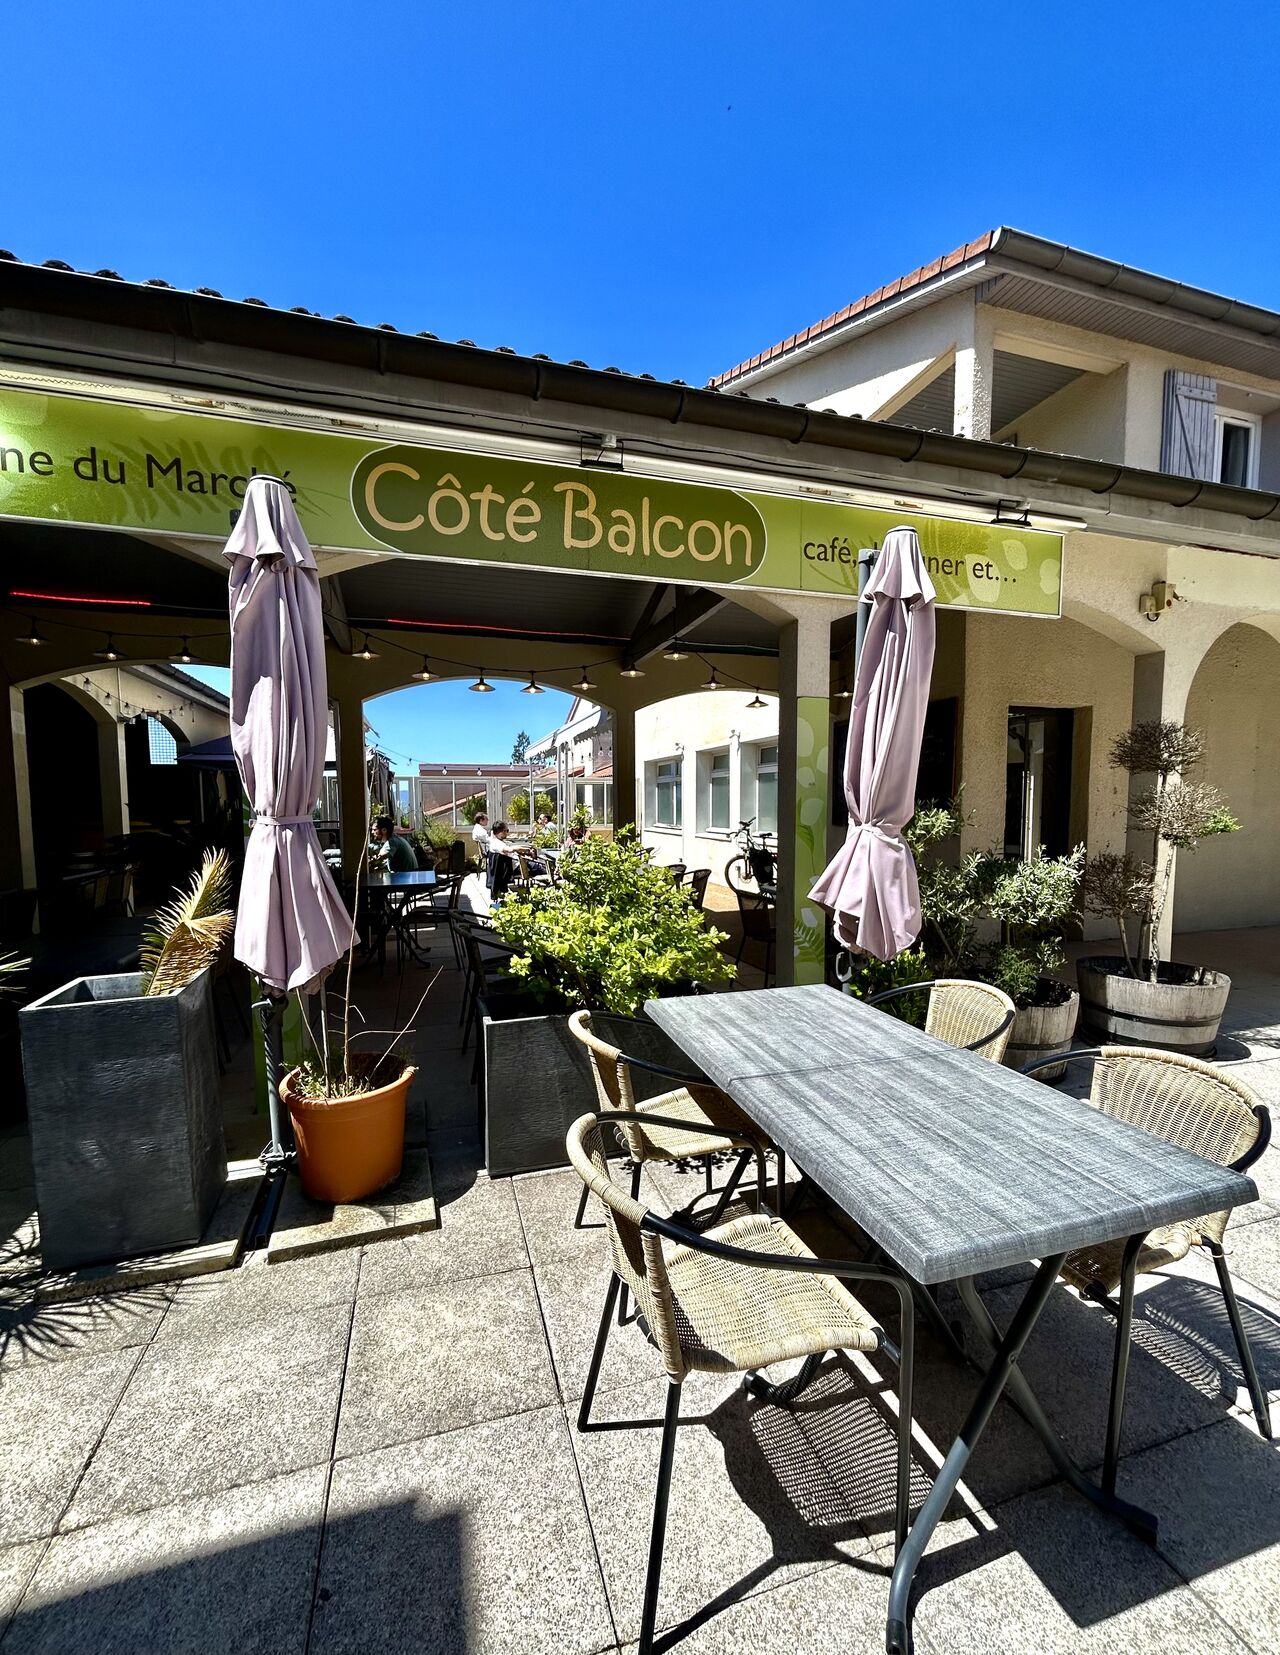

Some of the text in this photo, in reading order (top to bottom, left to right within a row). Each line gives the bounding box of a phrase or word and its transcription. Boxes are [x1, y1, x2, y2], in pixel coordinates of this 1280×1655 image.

[73, 446, 126, 485] du
[365, 462, 752, 567] Côté Balcon
[803, 537, 857, 568] café,
[972, 561, 1017, 583] et...
